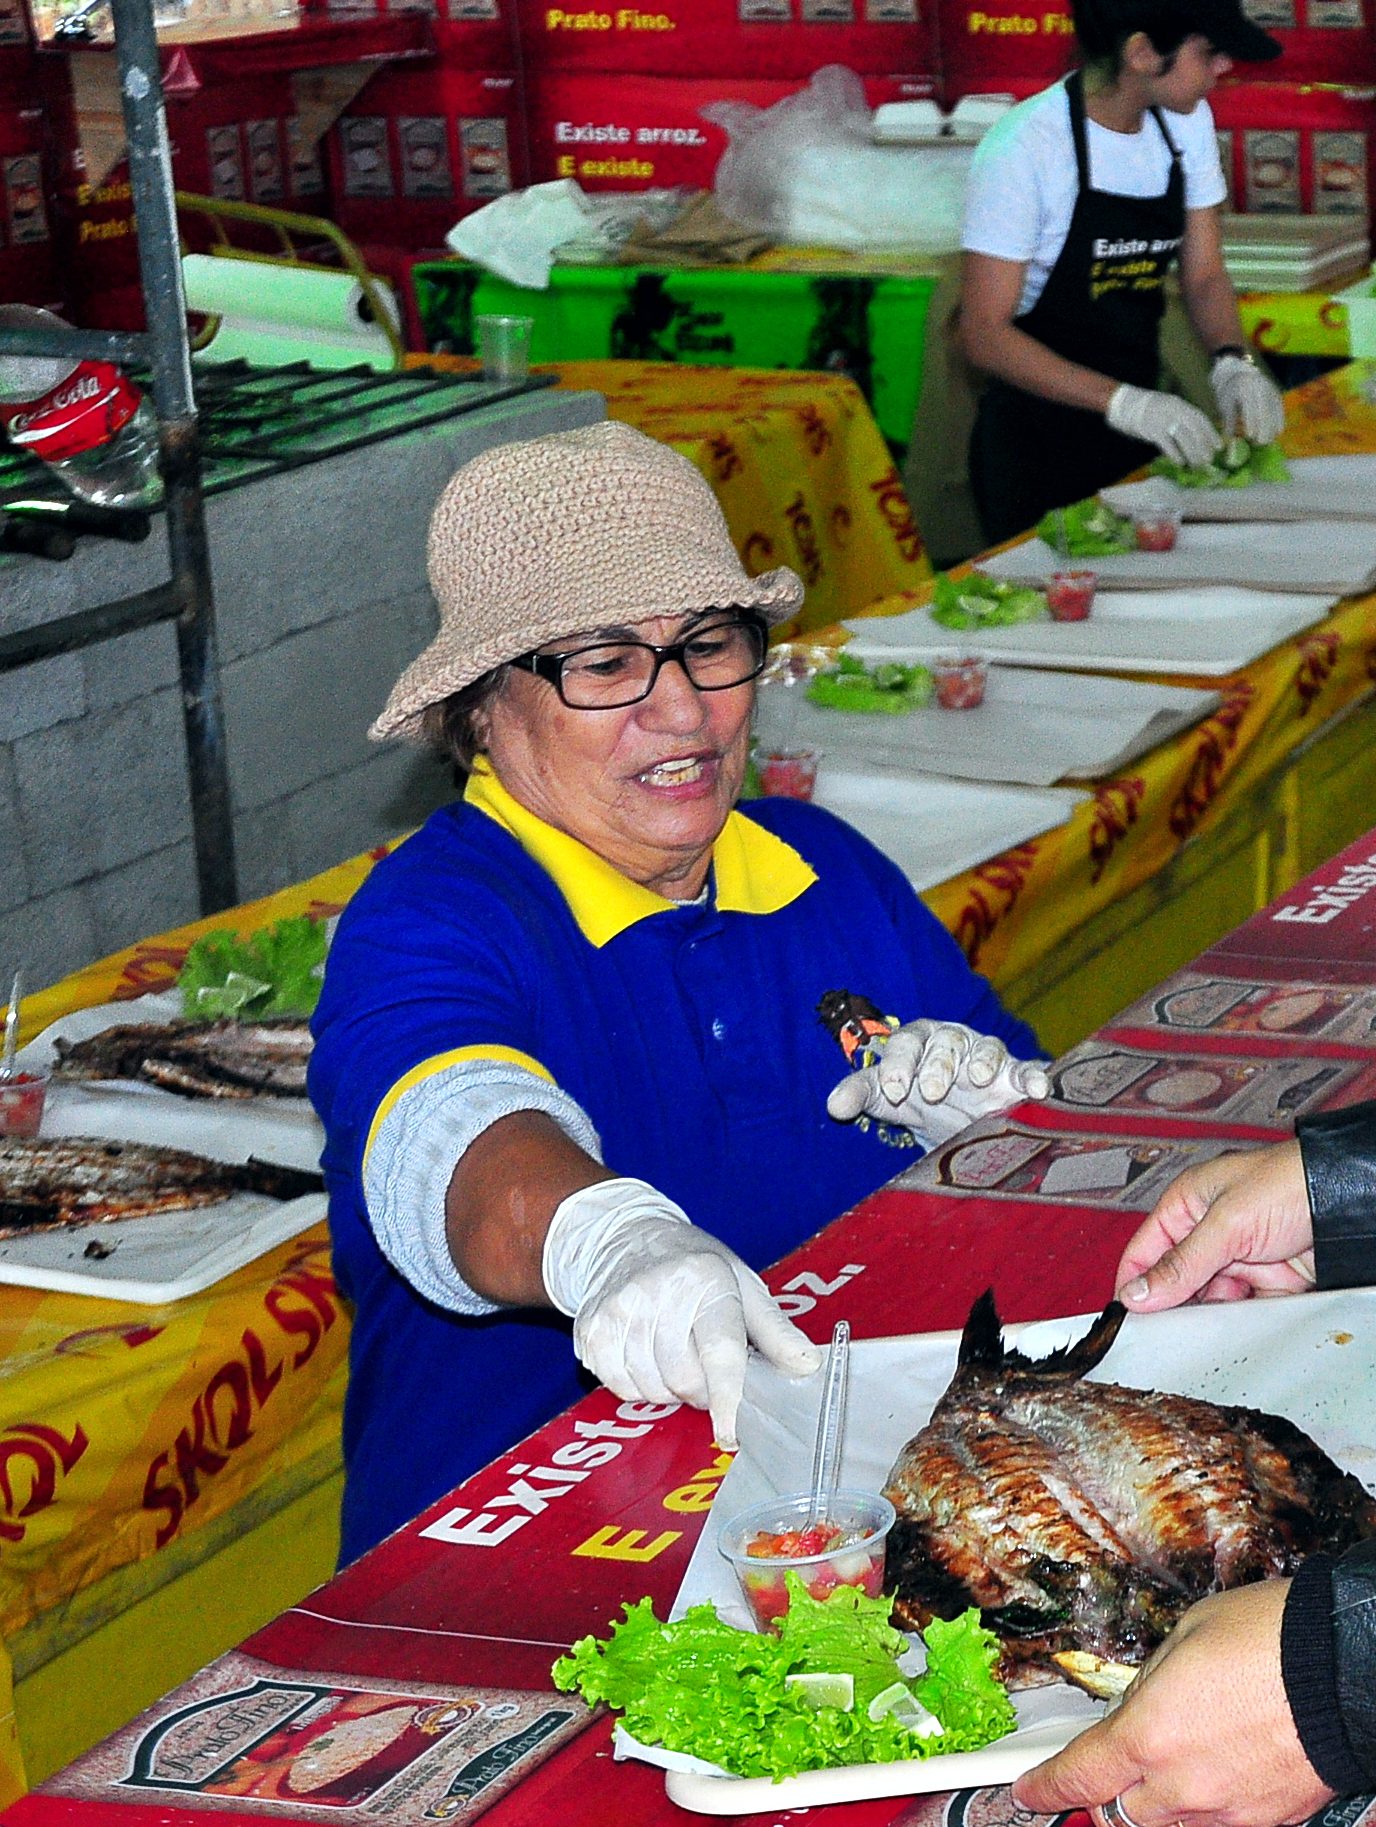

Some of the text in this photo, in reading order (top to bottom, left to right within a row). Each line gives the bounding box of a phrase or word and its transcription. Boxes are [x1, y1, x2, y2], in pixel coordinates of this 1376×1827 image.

[546, 9, 612, 30] Prato
[968, 12, 1038, 33] Prato
[555, 121, 707, 145] Existe arroz.
[557, 155, 655, 178] E existe
[1093, 238, 1148, 259] Existe
[419, 1264, 867, 1547] Existe oz.
[142, 1329, 285, 1549] SKOL
[571, 1524, 684, 1562] E
[215, 1694, 289, 1733] Fino
[490, 1733, 540, 1762] Fino
